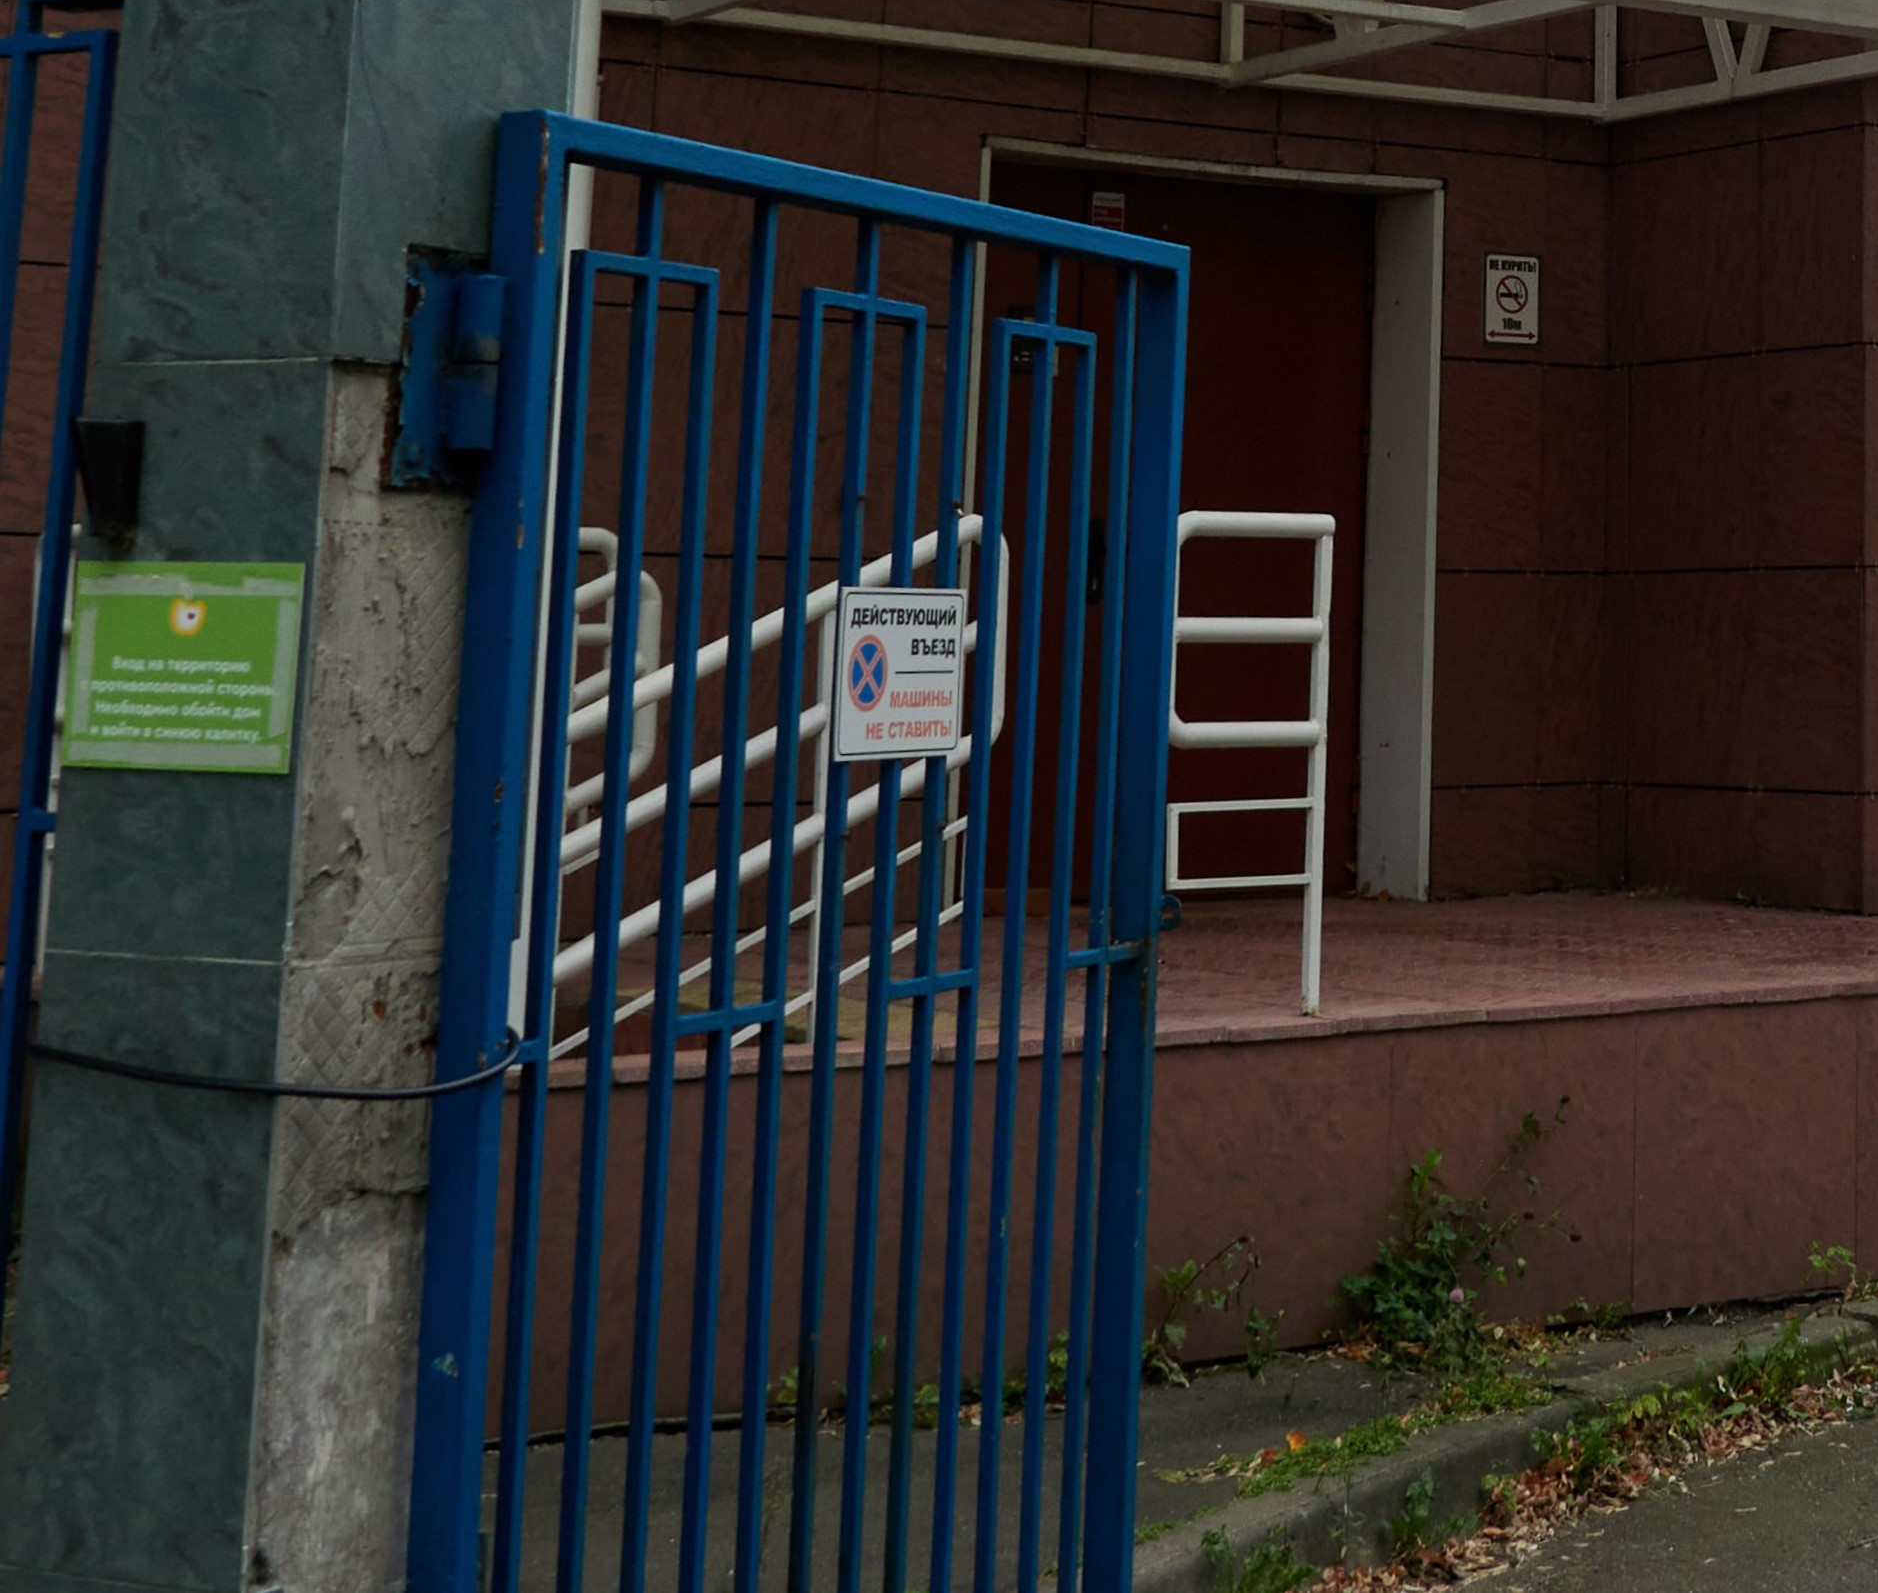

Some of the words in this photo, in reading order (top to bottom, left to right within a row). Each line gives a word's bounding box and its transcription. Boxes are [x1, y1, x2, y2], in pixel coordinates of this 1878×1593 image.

[1489, 259, 1499, 270] НЕ
[851, 605, 957, 628] ДЕЙСТВУЮЩИЙ
[911, 638, 955, 658] ВЪЕЗД
[112, 655, 145, 671] Вход
[168, 659, 251, 675] территорию
[890, 690, 952, 708] МАШИНЫ
[865, 721, 884, 740] НЕ
[888, 719, 952, 738] СТАВИТЬ!
